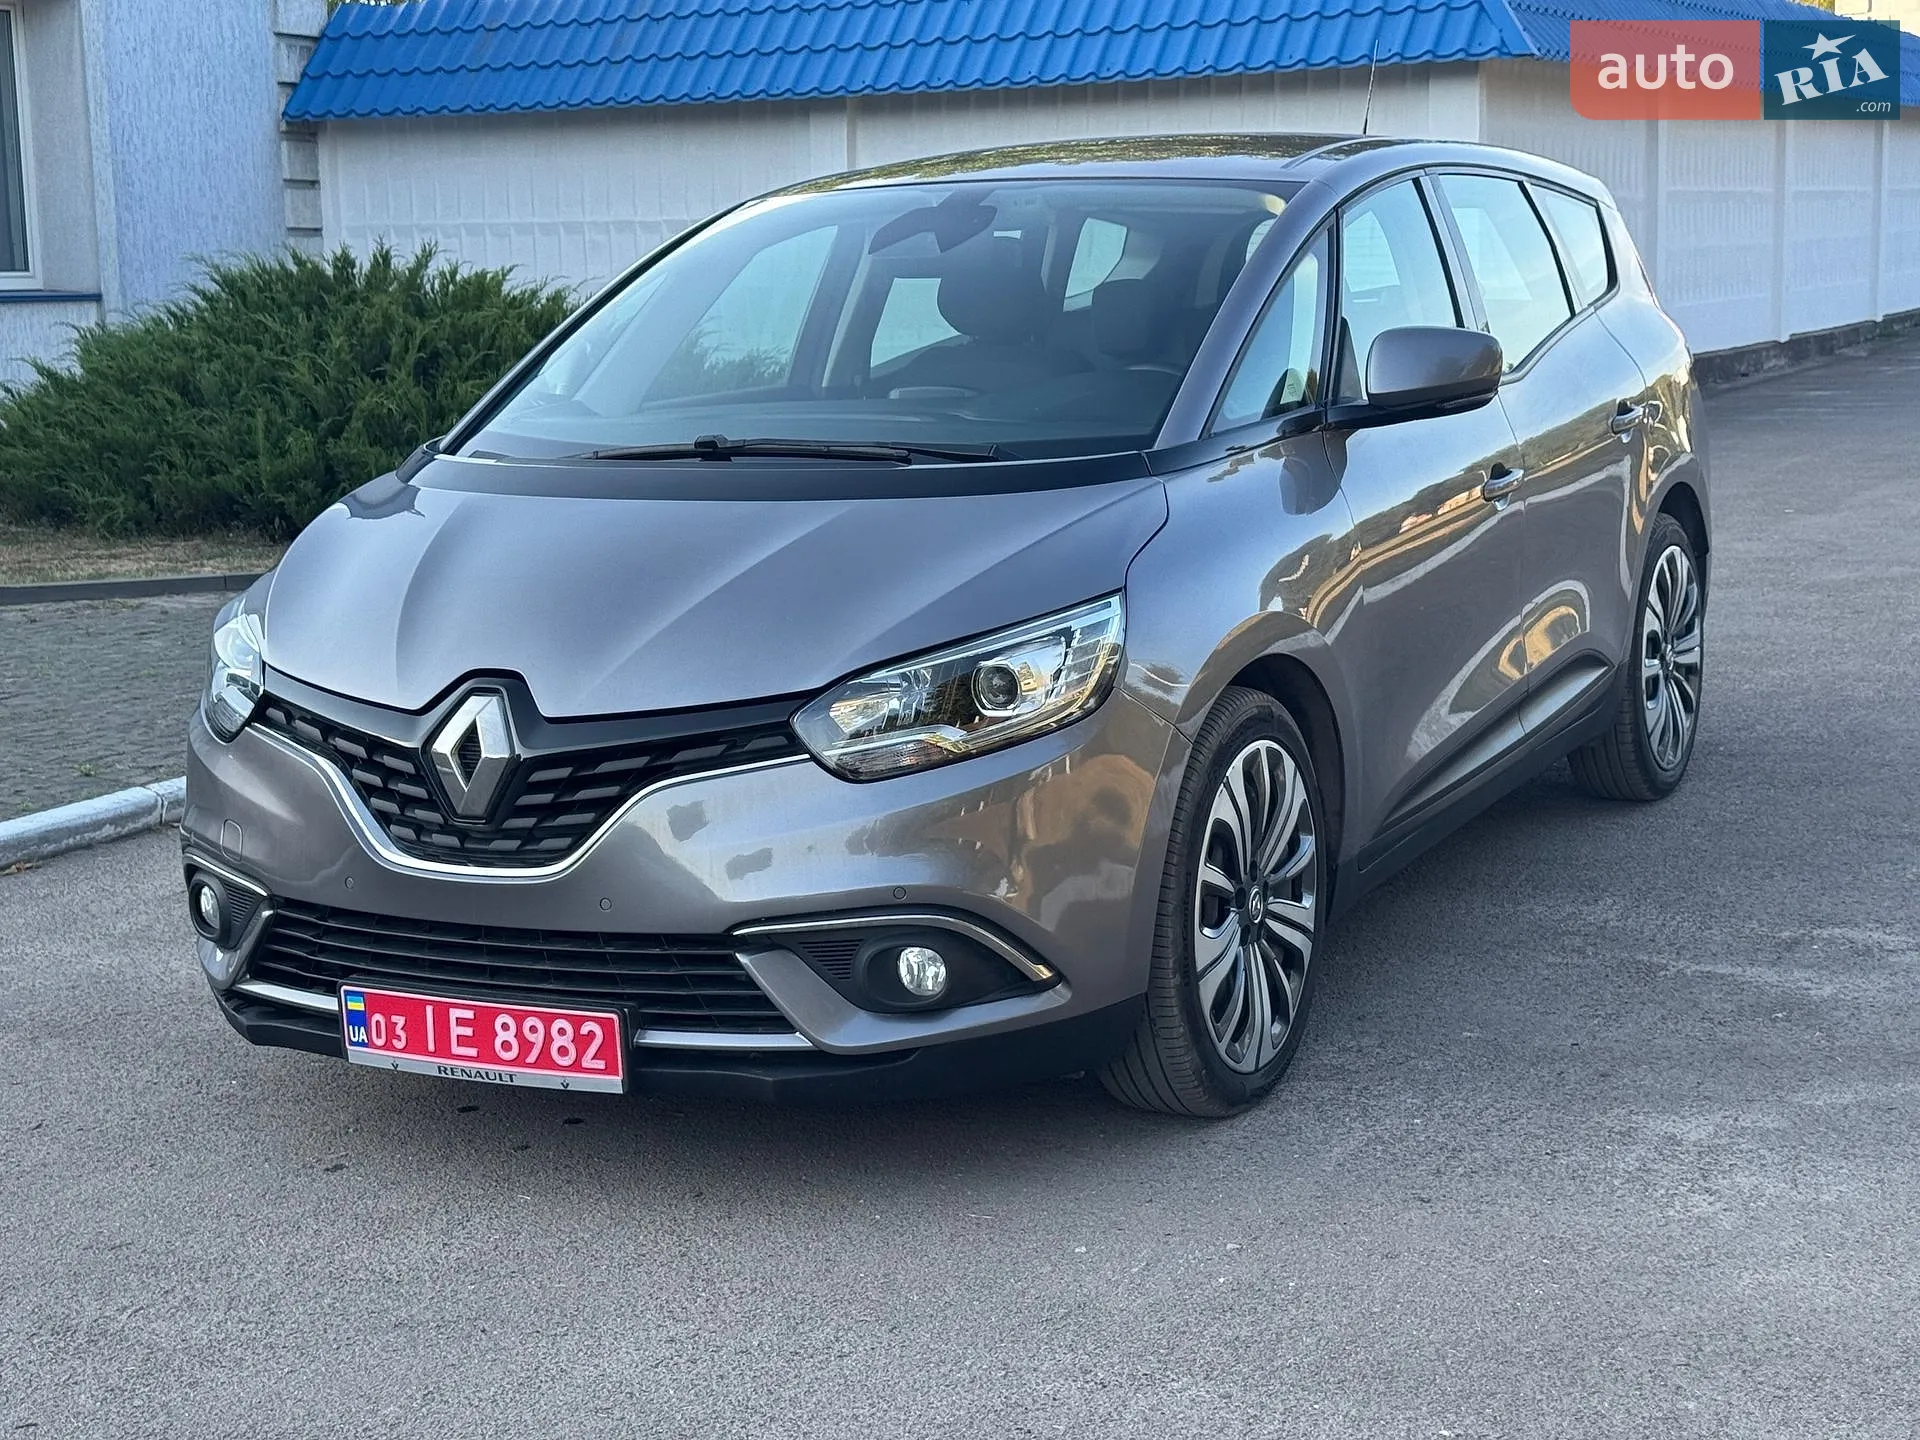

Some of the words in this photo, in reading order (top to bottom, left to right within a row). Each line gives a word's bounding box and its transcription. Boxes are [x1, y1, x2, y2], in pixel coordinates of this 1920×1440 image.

[349, 1025, 369, 1044] UA
[371, 1012, 408, 1050] 03
[425, 1004, 479, 1058] IE
[493, 1013, 607, 1070] 8982
[437, 1064, 518, 1084] RENAULT
